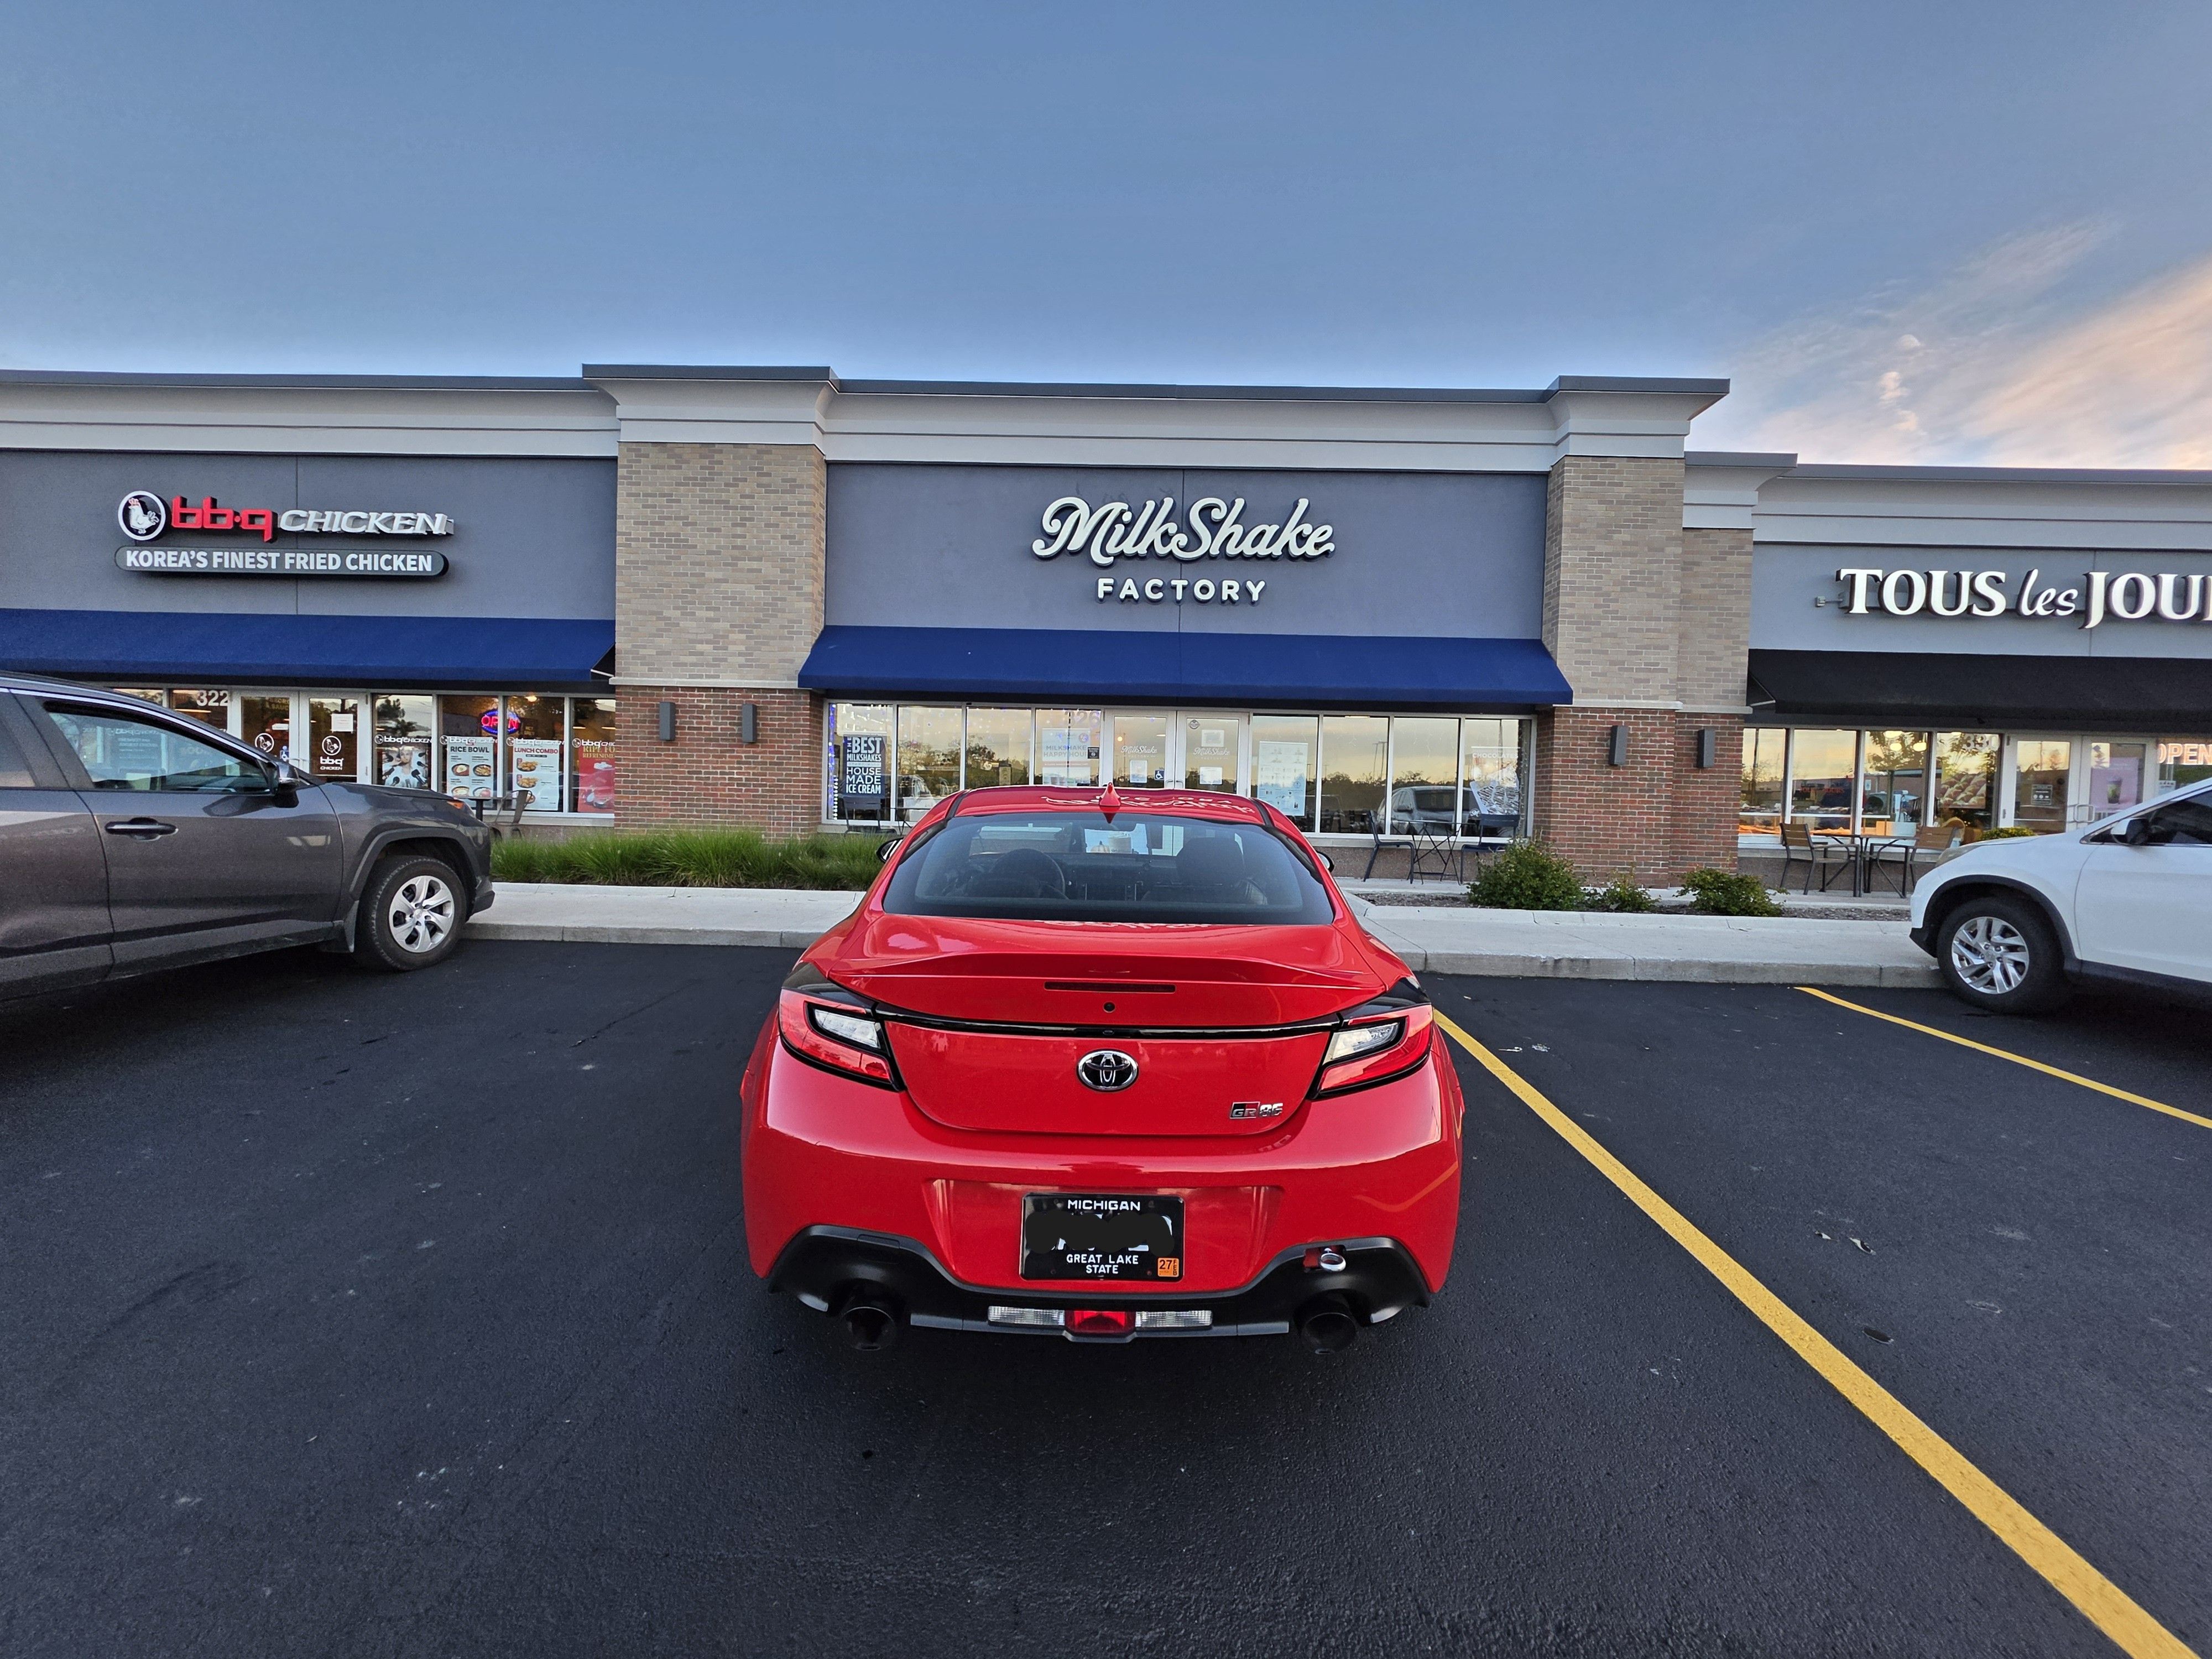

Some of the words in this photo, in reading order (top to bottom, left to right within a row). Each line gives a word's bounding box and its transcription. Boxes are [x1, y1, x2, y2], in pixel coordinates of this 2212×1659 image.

[279, 508, 447, 535] CHICKEN
[1032, 496, 1335, 566] MilkShake
[126, 550, 207, 568] KOREA'S
[212, 551, 280, 570] FINEST
[284, 552, 341, 570] FRIED
[345, 554, 432, 572] CHICKEN
[1097, 577, 1265, 603] FACTORY
[1836, 568, 2007, 617] TOUS
[2017, 568, 2078, 617] les
[2078, 571, 2212, 630] JOU
[196, 690, 229, 707] 322
[481, 714, 520, 729] OPN
[852, 737, 882, 754] BEST
[847, 753, 881, 761] MILKSHAKES
[846, 767, 881, 775] HOUSE
[846, 775, 881, 785] MADE
[846, 784, 857, 794] ICE
[858, 784, 881, 794] CREAM
[1067, 1199, 1141, 1211] MICHIGAN
[1066, 1254, 1103, 1264] GREAT
[1108, 1255, 1139, 1265] LAKE
[1159, 1259, 1173, 1270] 27
[1086, 1264, 1119, 1275] STATE
